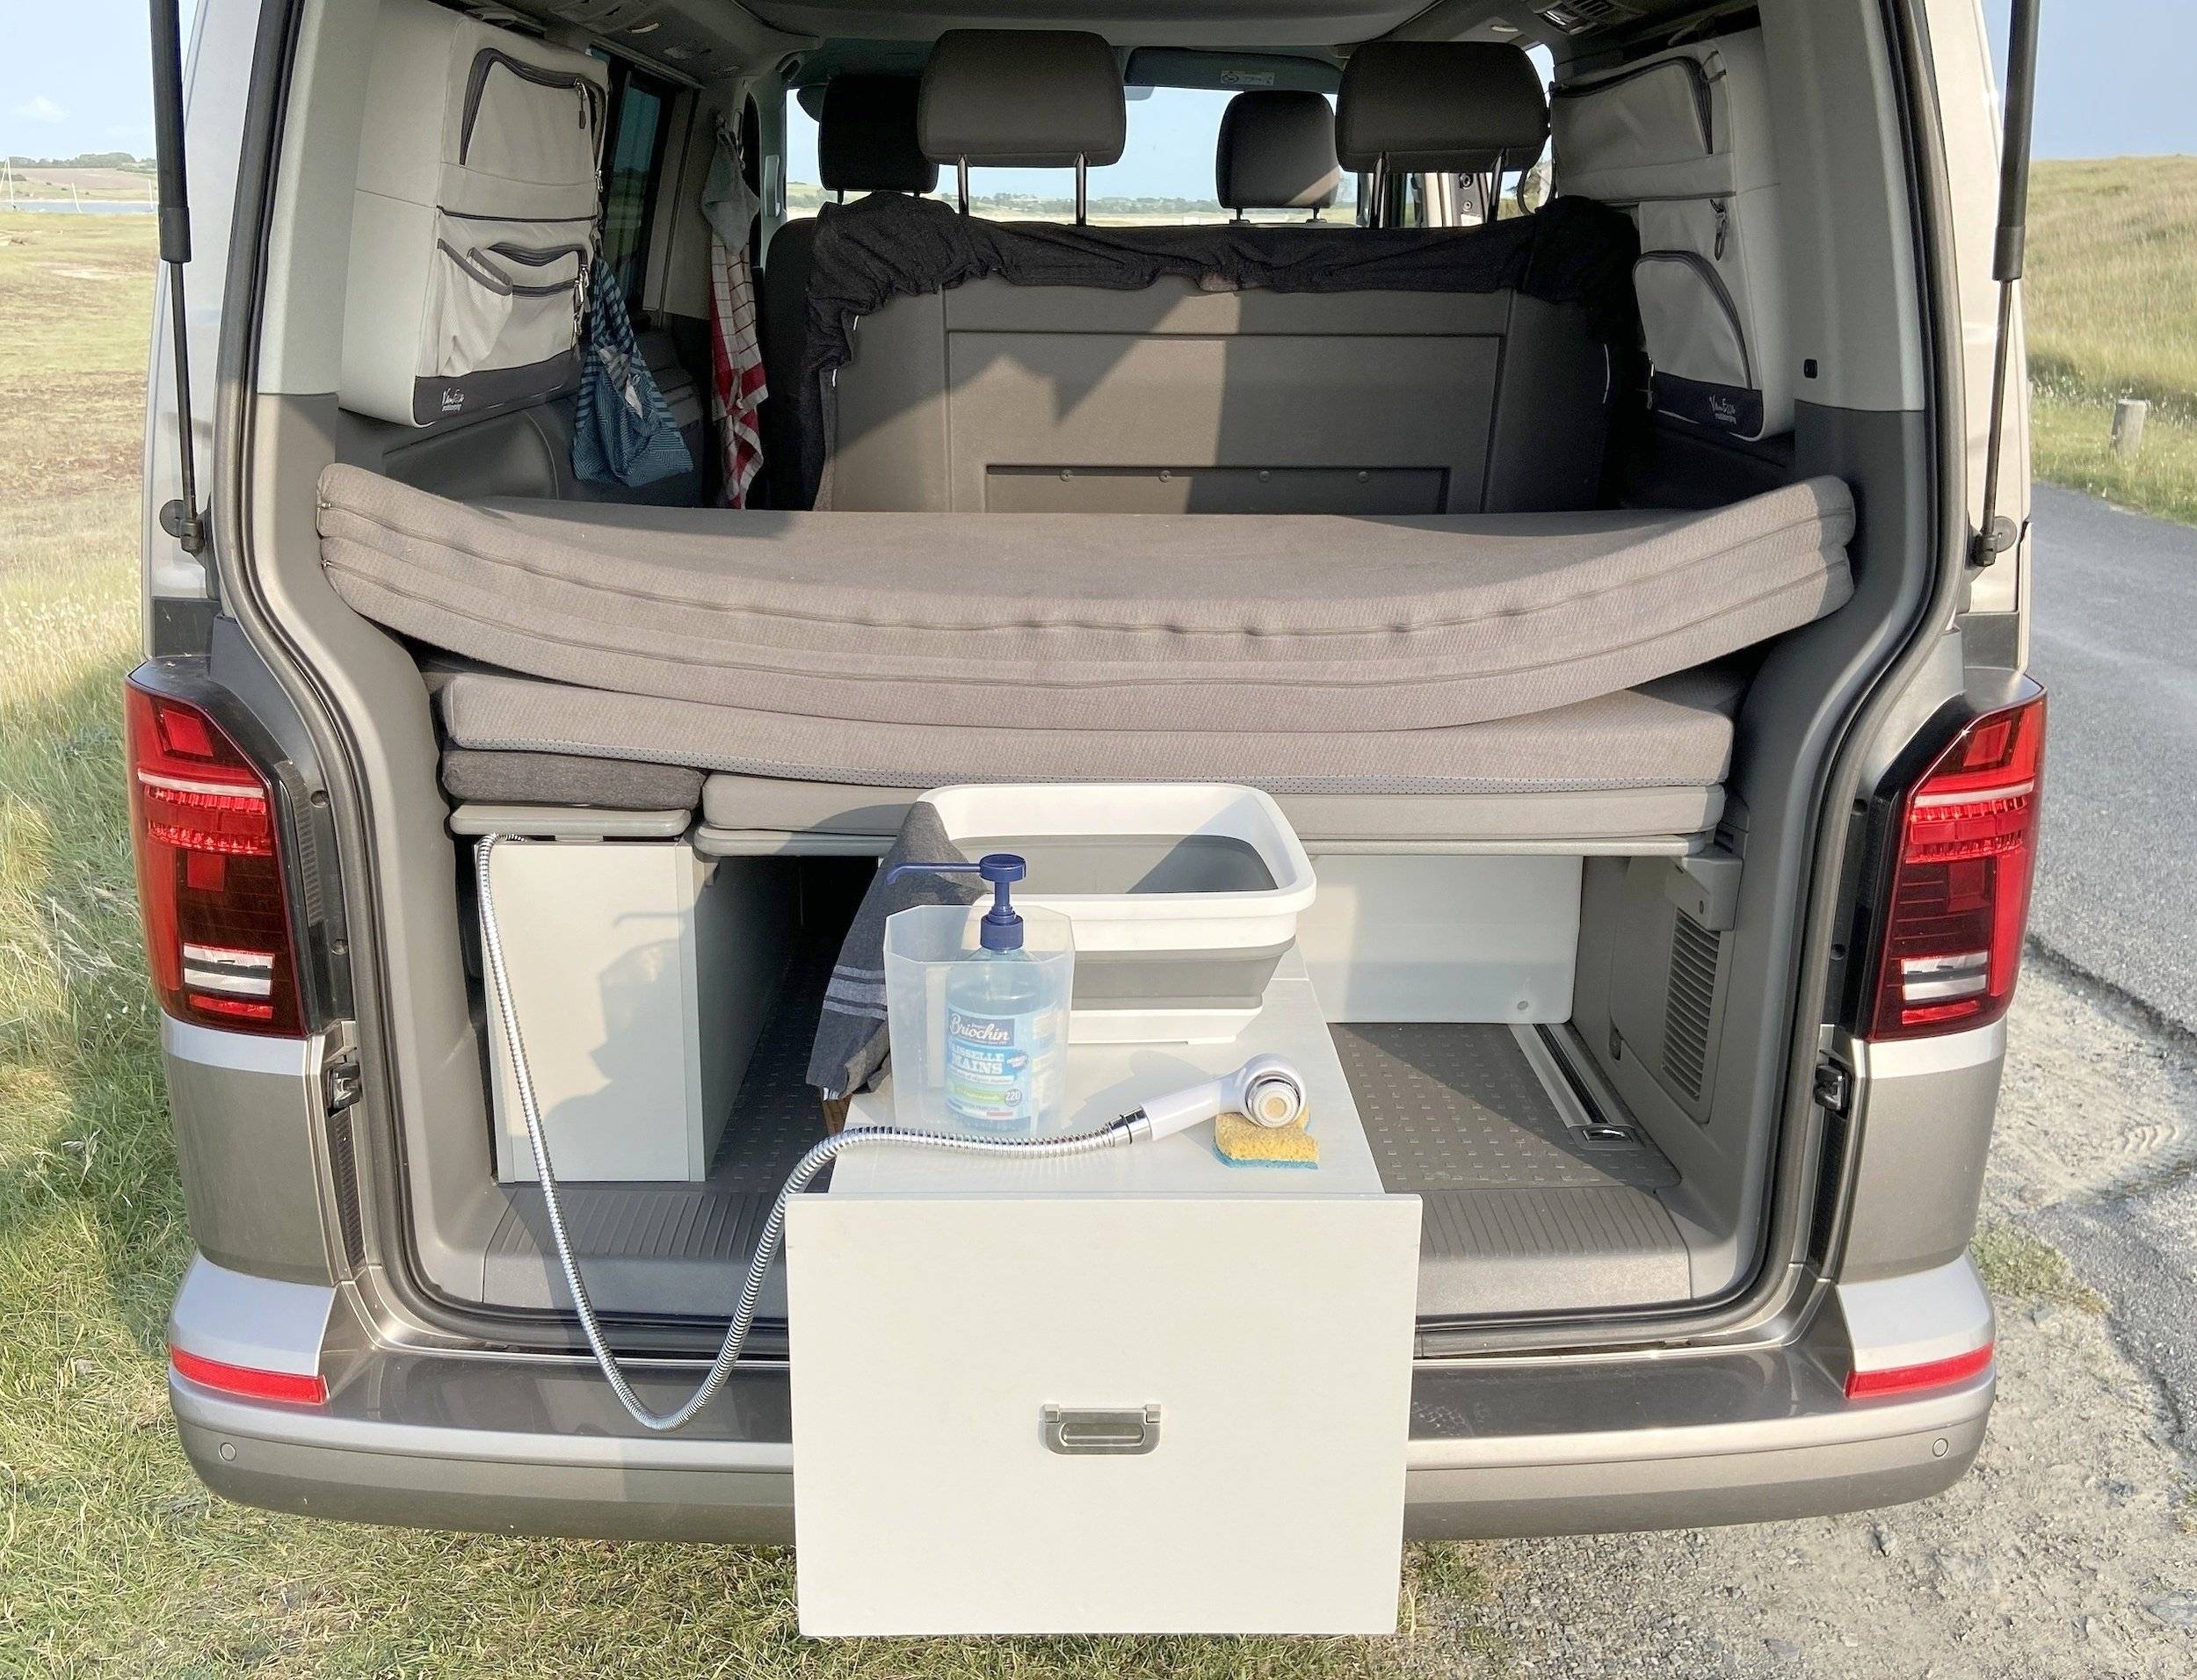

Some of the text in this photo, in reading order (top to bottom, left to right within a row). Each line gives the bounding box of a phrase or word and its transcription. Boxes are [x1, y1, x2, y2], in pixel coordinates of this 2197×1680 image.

[949, 1013, 1011, 1041] Briochin
[952, 1053, 1003, 1074] MAINS
[1005, 1091, 1021, 1101] 220
